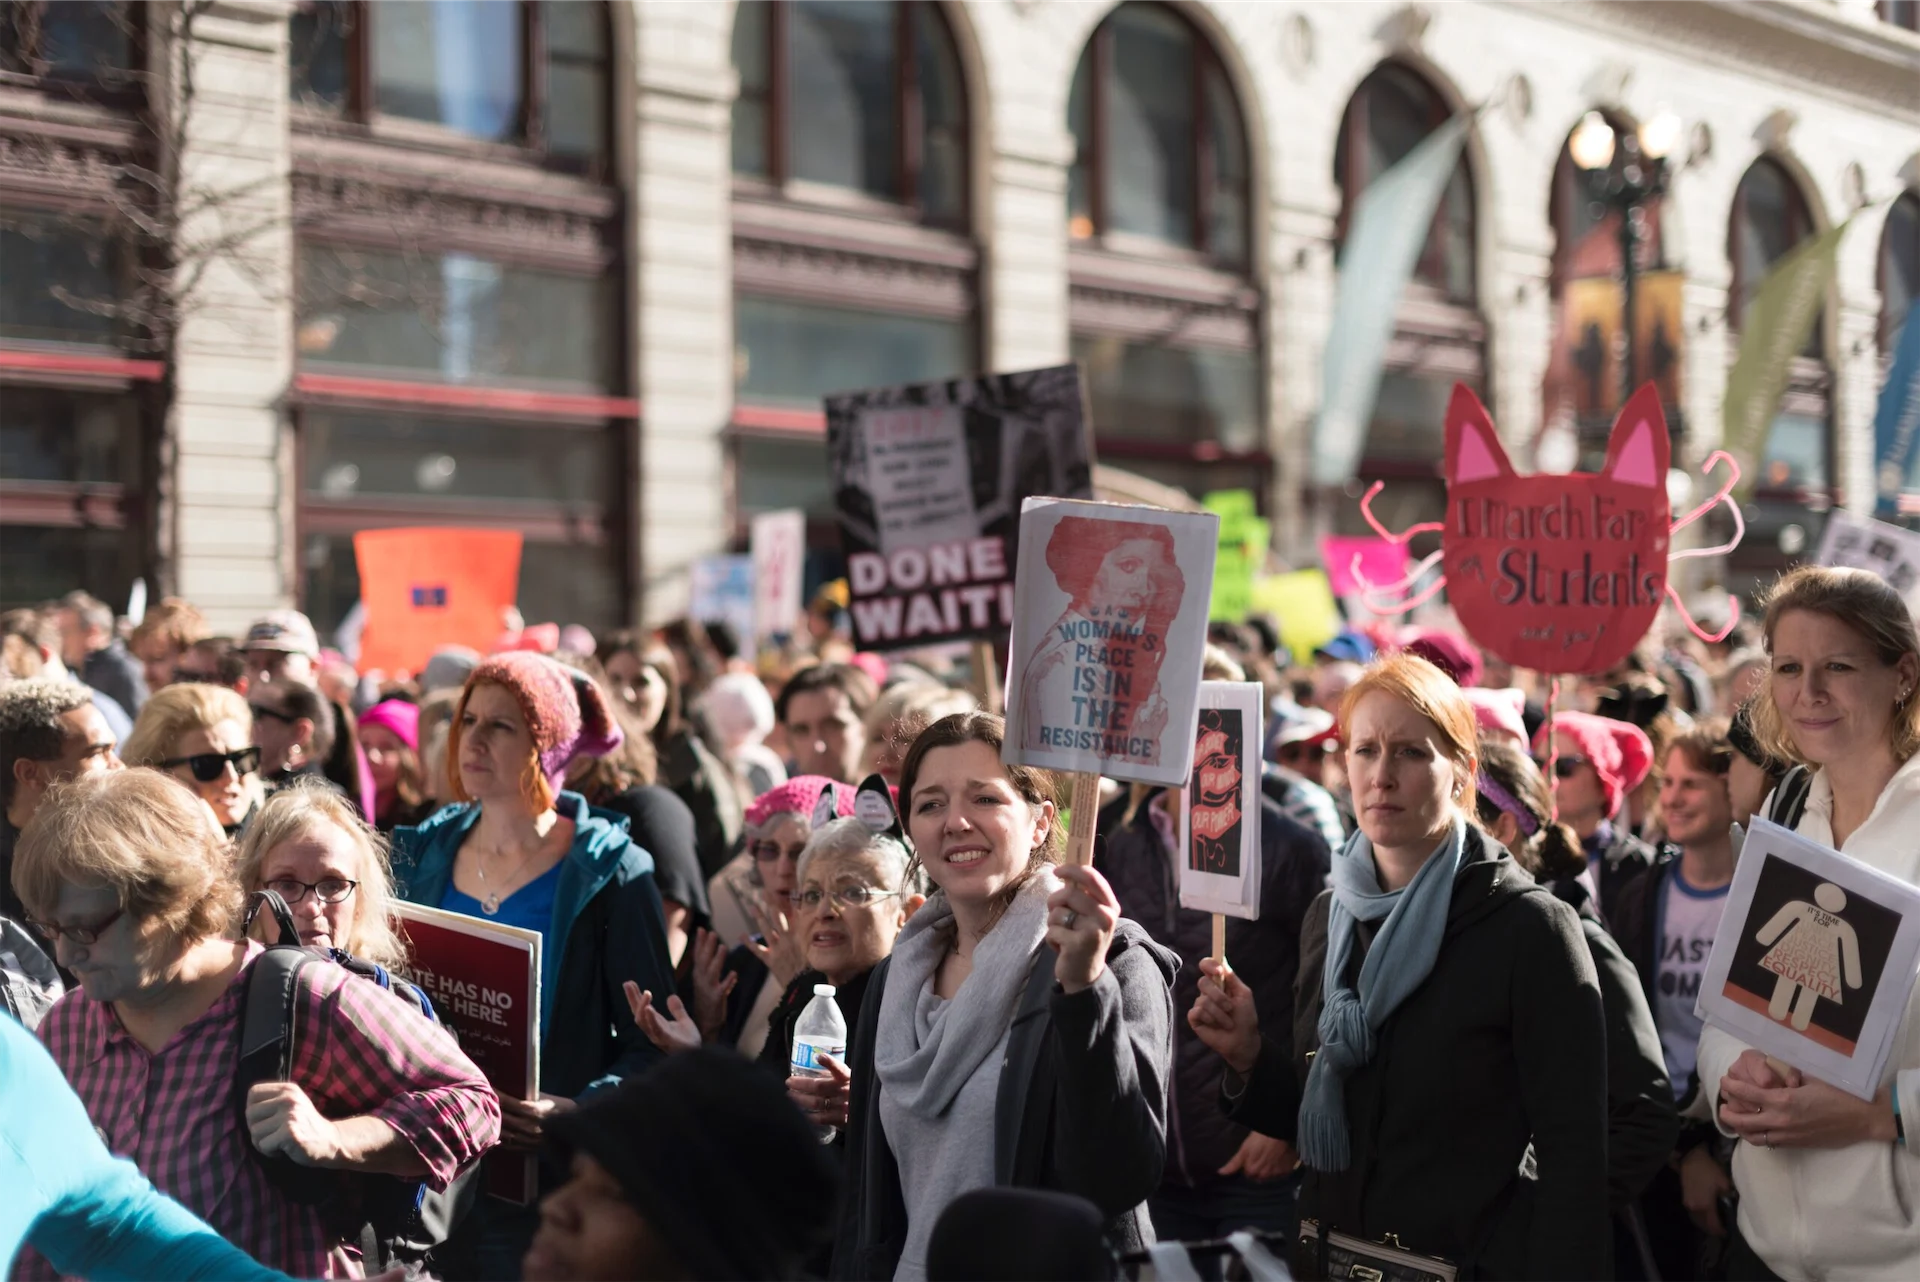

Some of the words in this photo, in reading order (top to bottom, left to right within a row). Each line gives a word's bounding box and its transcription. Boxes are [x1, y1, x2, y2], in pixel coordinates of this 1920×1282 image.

[1457, 498, 1474, 537] I
[848, 537, 1007, 596] DONE
[1492, 547, 1662, 606] Students
[852, 583, 1014, 642] WAITI
[1104, 606, 1112, 616] A
[1058, 619, 1158, 652] WOMAN'S
[1075, 643, 1136, 668] PLACE
[1073, 667, 1096, 692] IS
[1103, 670, 1132, 696] IN
[1071, 696, 1130, 732] THE
[1039, 726, 1154, 757] RESISTANCE
[1193, 811, 1209, 830] OUR
[1210, 803, 1234, 833] POWER
[1807, 907, 1821, 918] IT'S
[1821, 913, 1840, 926] TIME
[1813, 916, 1831, 929] FOR
[1787, 934, 1836, 963] JUSTICE
[1796, 926, 1835, 951] PEACE
[1773, 948, 1838, 986] RESPECT
[1780, 940, 1836, 973] DIGNITY
[401, 966, 436, 989] ATE
[439, 975, 478, 1000] HAS
[481, 987, 513, 1010] NO
[1763, 956, 1840, 999] EQUALITY
[454, 997, 508, 1027] HERE.
